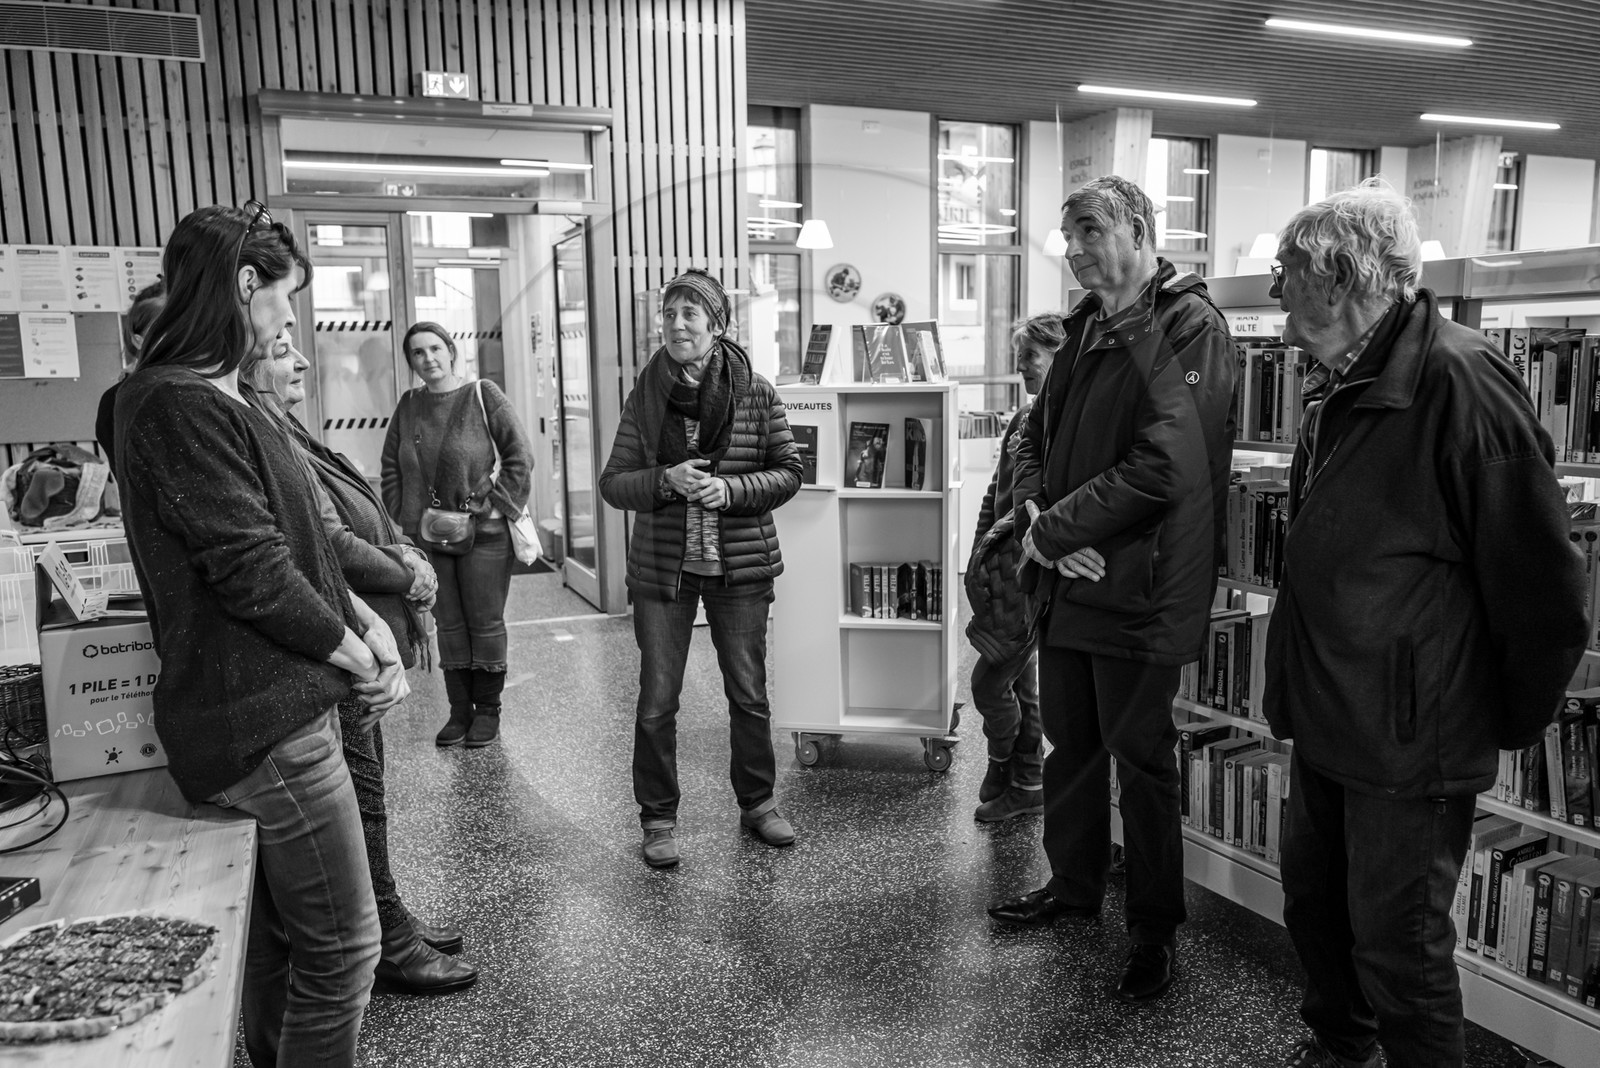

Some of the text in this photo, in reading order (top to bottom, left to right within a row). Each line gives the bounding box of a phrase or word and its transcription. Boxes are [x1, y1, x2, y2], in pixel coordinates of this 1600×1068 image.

[782, 402, 832, 411] OUVEAUTES
[69, 683, 76, 695] 1
[82, 679, 117, 694] PILE
[135, 675, 141, 686] 1
[147, 674, 160, 685] D
[90, 696, 109, 705] pour
